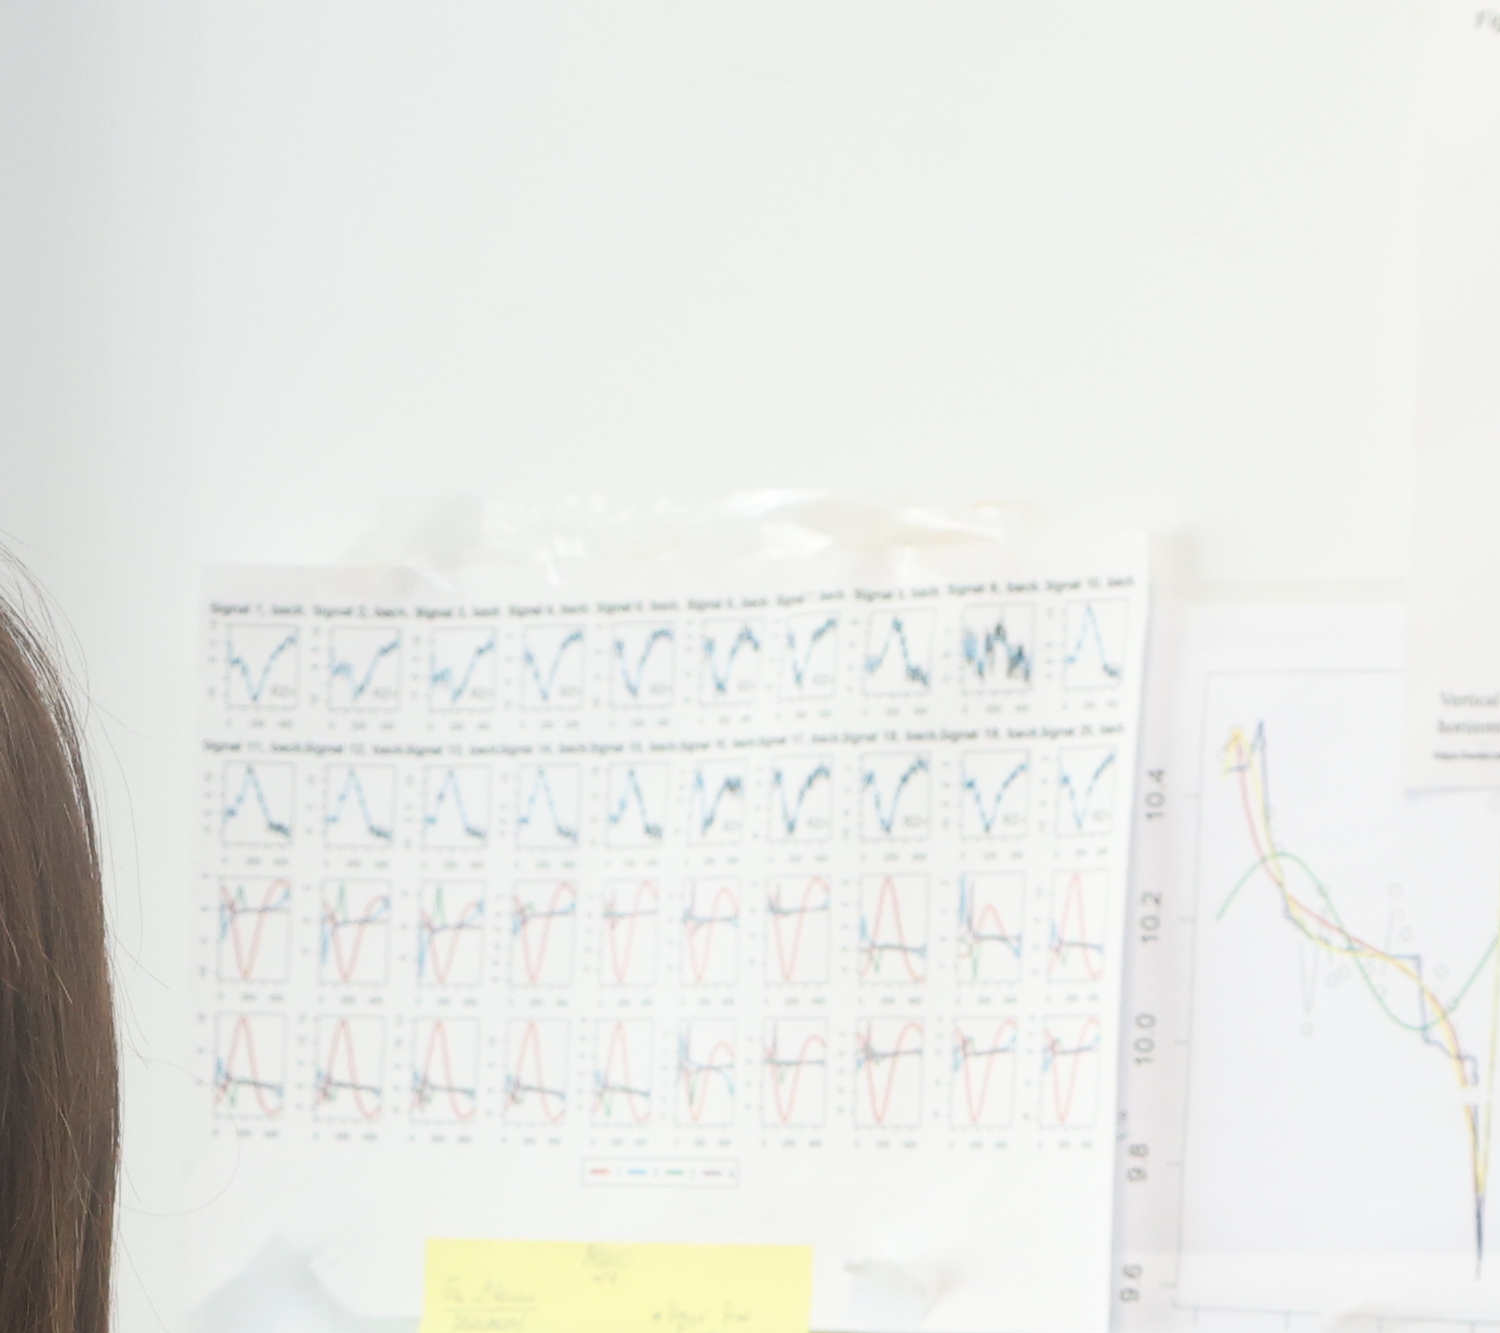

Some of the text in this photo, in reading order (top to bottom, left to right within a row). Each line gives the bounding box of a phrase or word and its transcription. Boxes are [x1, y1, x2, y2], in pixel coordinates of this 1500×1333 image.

[1440, 693, 1500, 708] Vertical
[1145, 768, 1166, 821] 10.4
[1140, 891, 1163, 944] 10.2
[1134, 1012, 1157, 1066] 10.0
[1126, 1143, 1150, 1183] 9.8
[1120, 1264, 1143, 1304] 9.6
